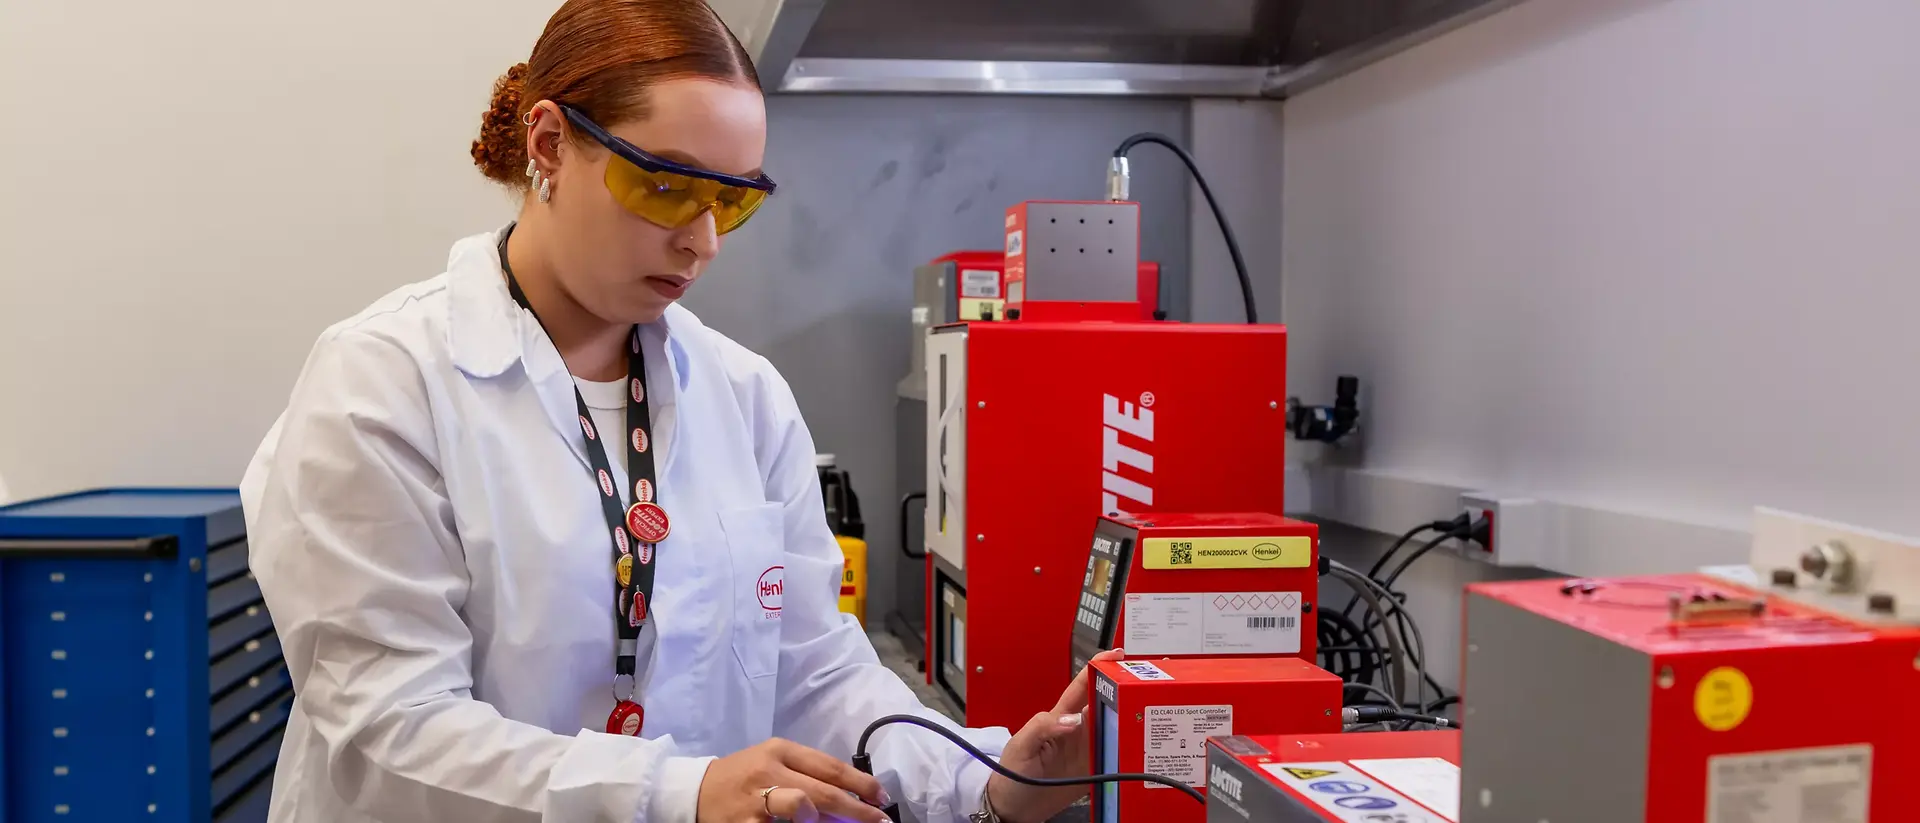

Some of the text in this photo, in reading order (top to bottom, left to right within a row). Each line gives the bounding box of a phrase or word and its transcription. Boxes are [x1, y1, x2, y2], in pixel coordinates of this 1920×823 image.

[633, 507, 666, 534] LOCTITE
[645, 507, 665, 524] EXPERT
[634, 516, 657, 537] OFFICIAL
[1095, 675, 1114, 702] LOCTITE
[1186, 708, 1199, 716] Spot
[1199, 707, 1227, 715] Controller
